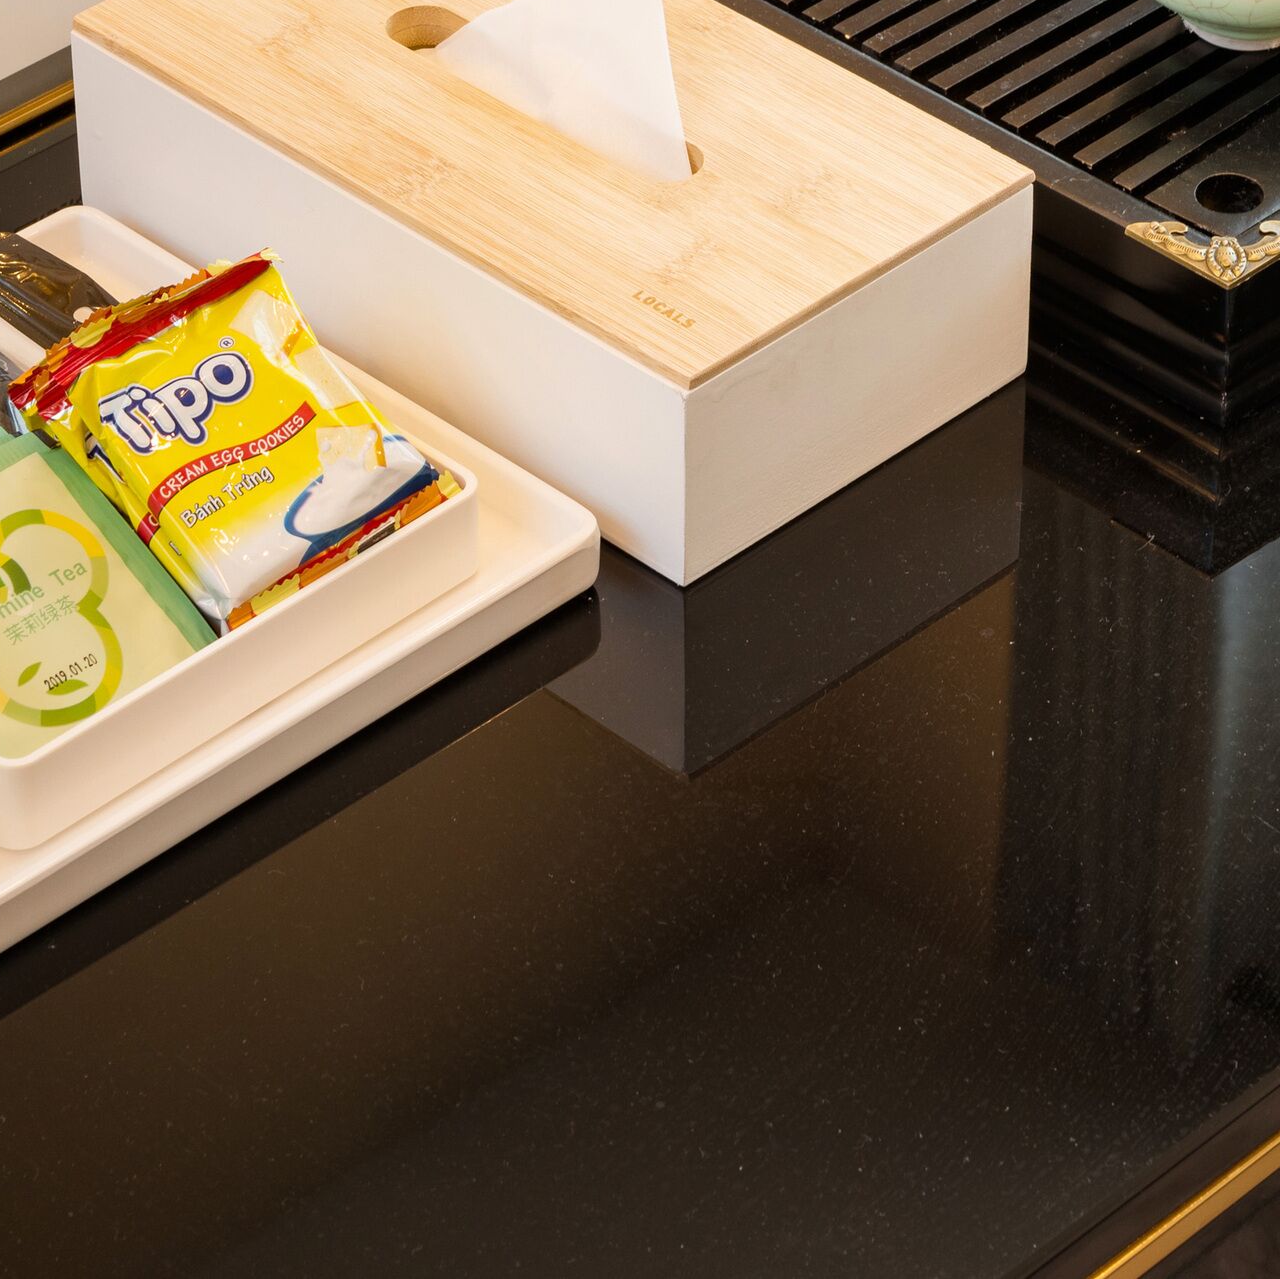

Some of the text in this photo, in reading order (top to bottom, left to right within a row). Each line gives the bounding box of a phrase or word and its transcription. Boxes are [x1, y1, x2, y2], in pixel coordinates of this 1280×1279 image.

[631, 290, 697, 329] LOCALS
[98, 351, 254, 455] Tipo
[159, 415, 305, 499] CREAM EGG COOKIES
[179, 494, 225, 529] Bánh
[48, 562, 88, 586] Tea
[3, 595, 75, 645] 茉莉绿茶
[43, 653, 98, 691] 2019.01.20
